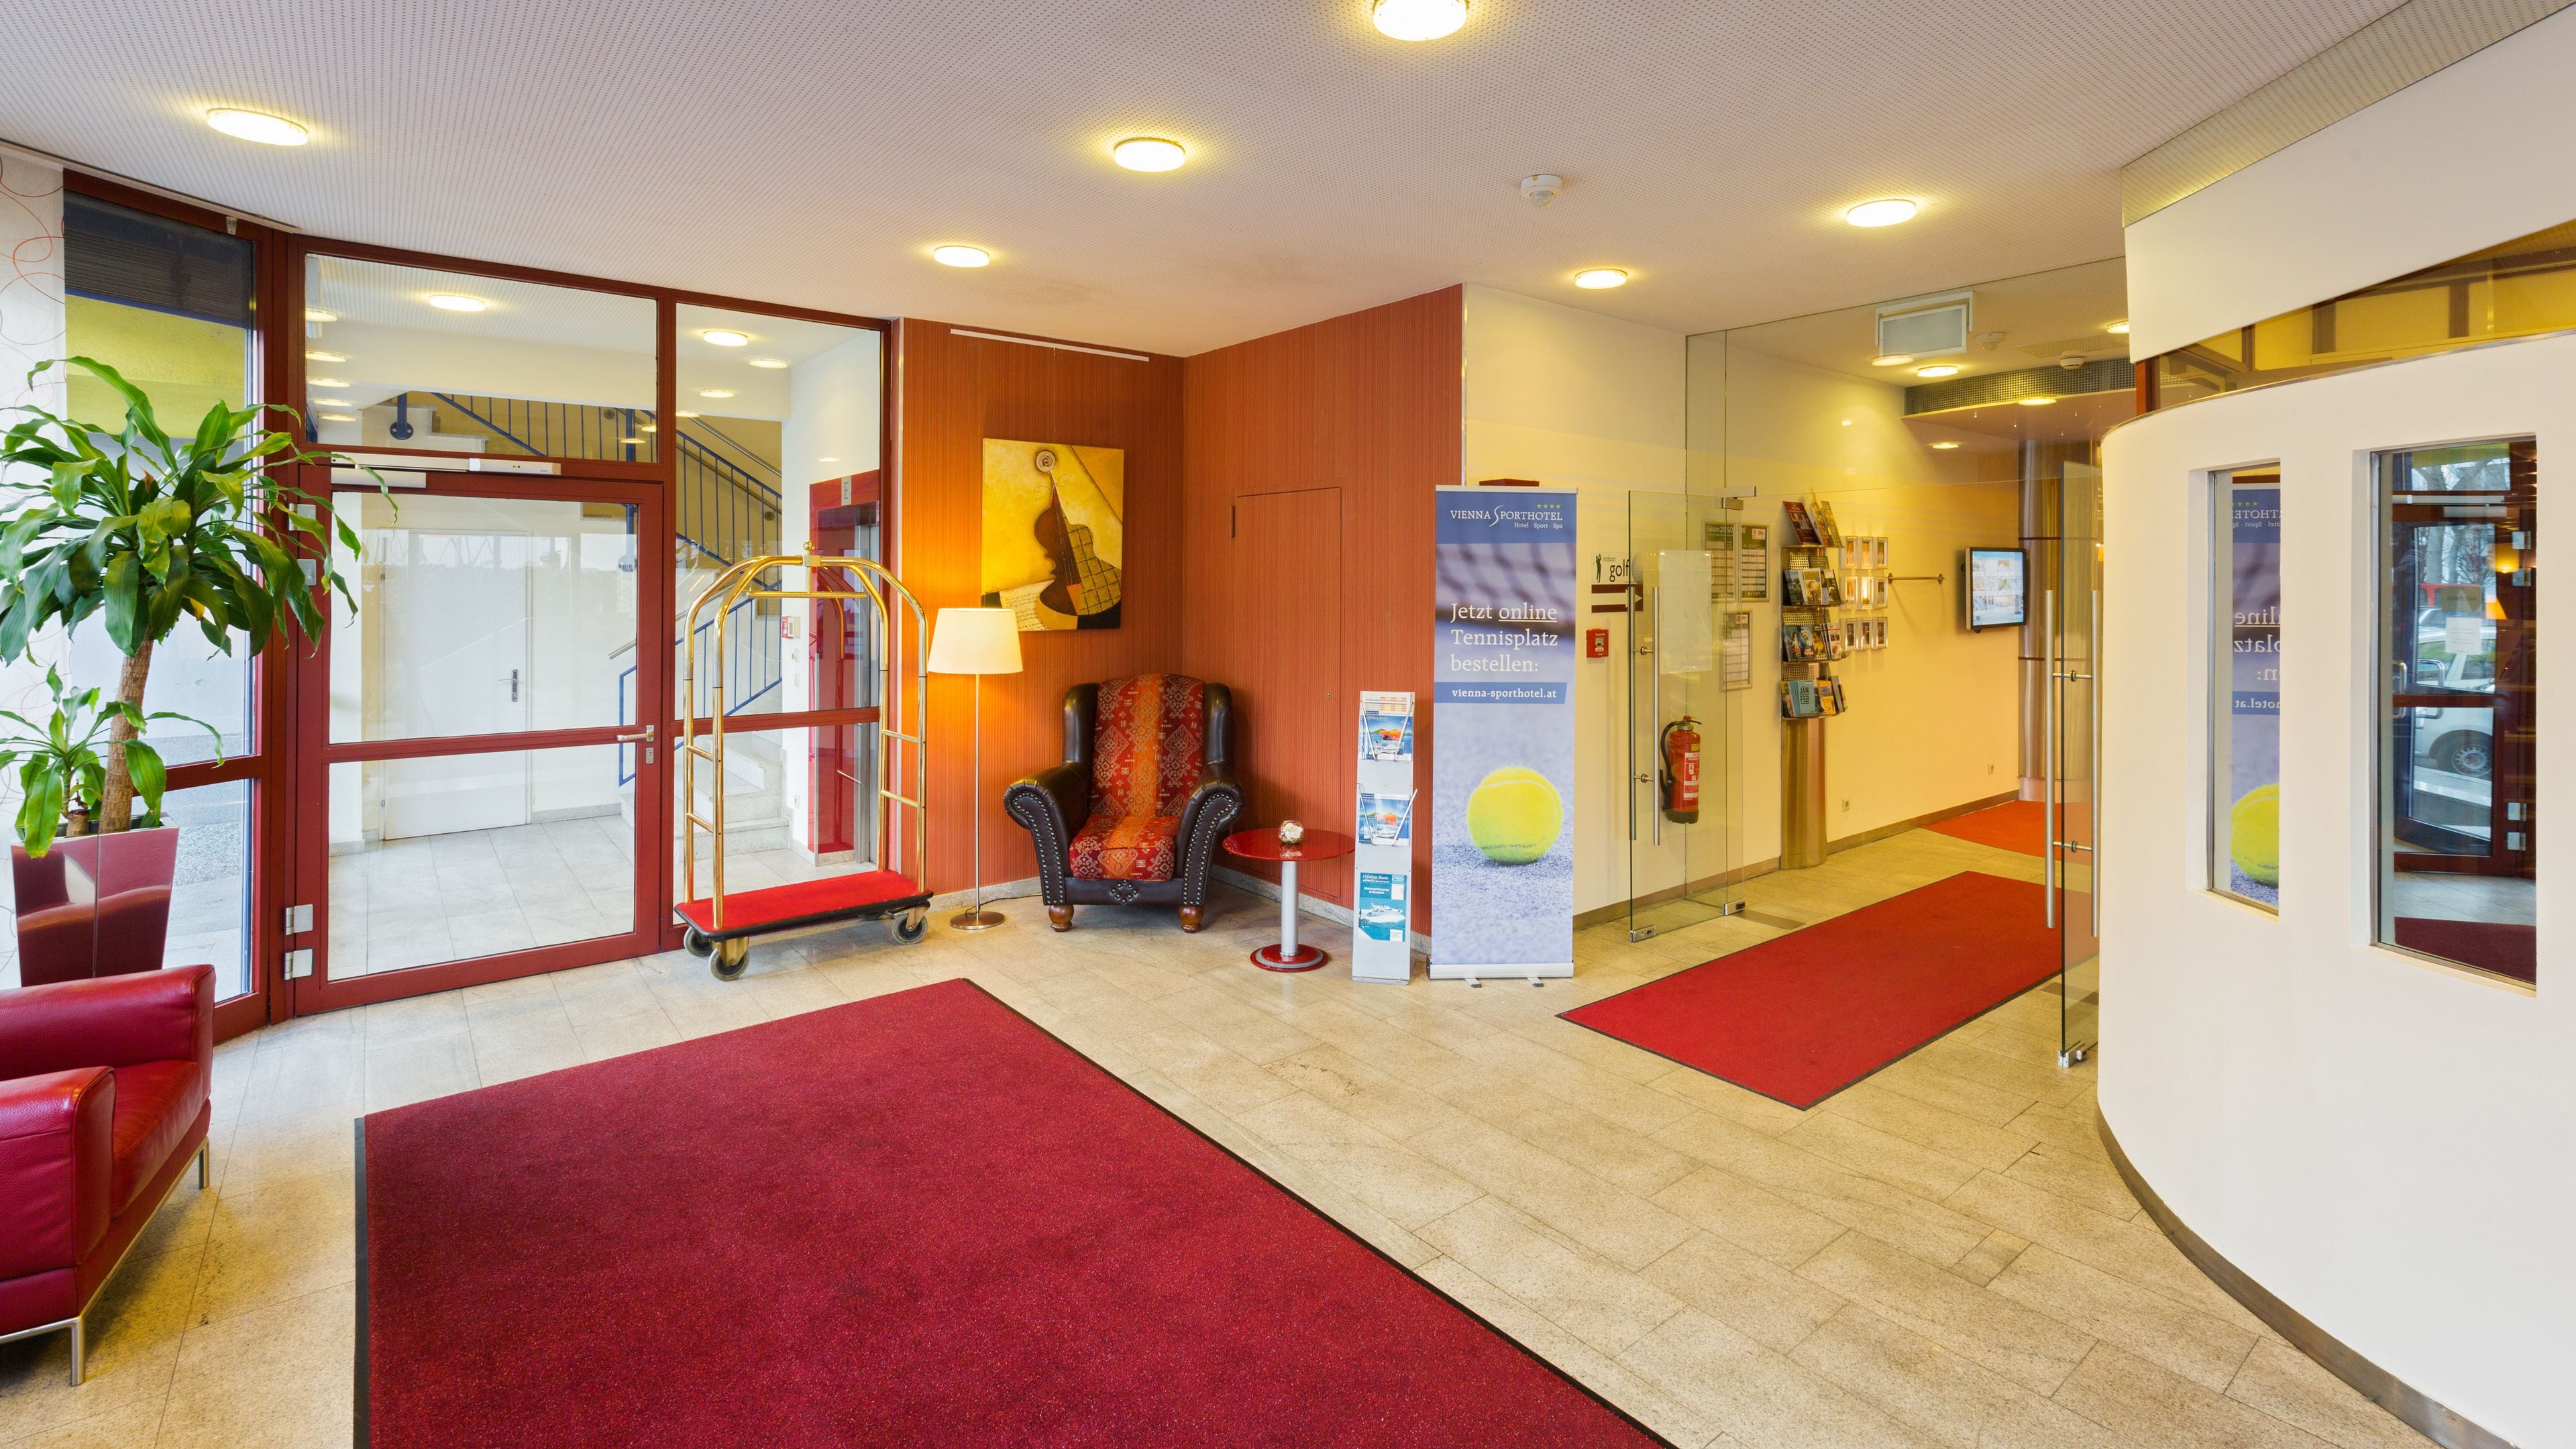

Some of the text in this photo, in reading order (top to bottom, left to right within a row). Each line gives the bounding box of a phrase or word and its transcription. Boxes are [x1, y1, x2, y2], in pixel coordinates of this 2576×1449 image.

[1450, 504, 1563, 527] VIENNA SPORTHOTEL
[1609, 559, 1629, 582] golf
[1450, 602, 1558, 623] Jetzt online
[1450, 628, 1558, 650] Tennisplatz
[1450, 654, 1539, 672] bestellen:
[1452, 688, 1557, 700] vienna-sporthotel.at
